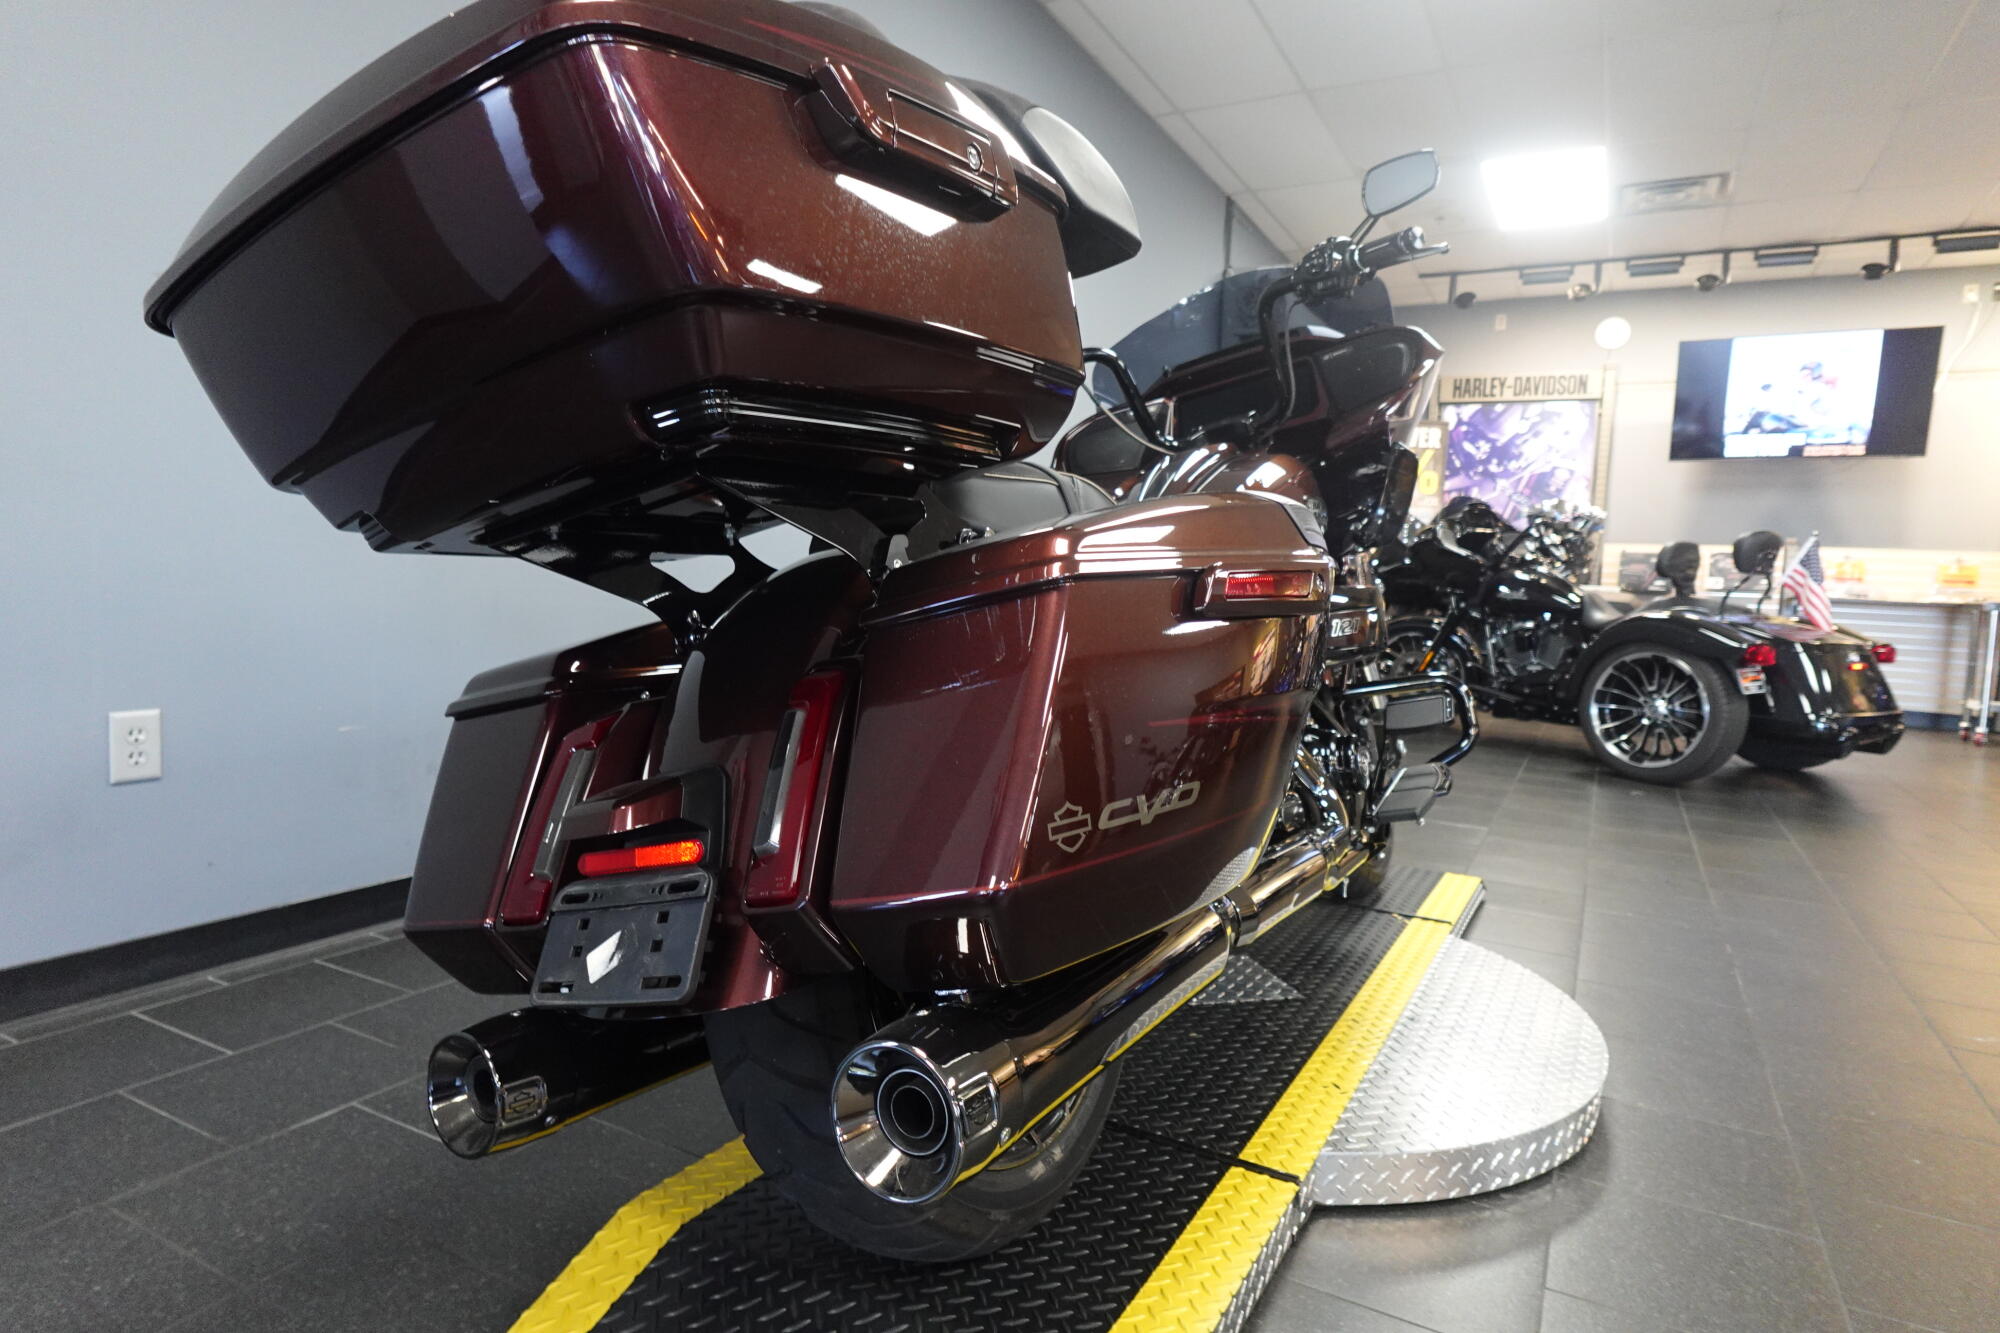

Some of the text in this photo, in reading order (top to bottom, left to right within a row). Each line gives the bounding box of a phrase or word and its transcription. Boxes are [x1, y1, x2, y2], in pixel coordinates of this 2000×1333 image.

[1452, 374, 1589, 399] HARLEY-DAVIDSON
[1331, 616, 1361, 638] 121
[1098, 780, 1201, 831] CVO
